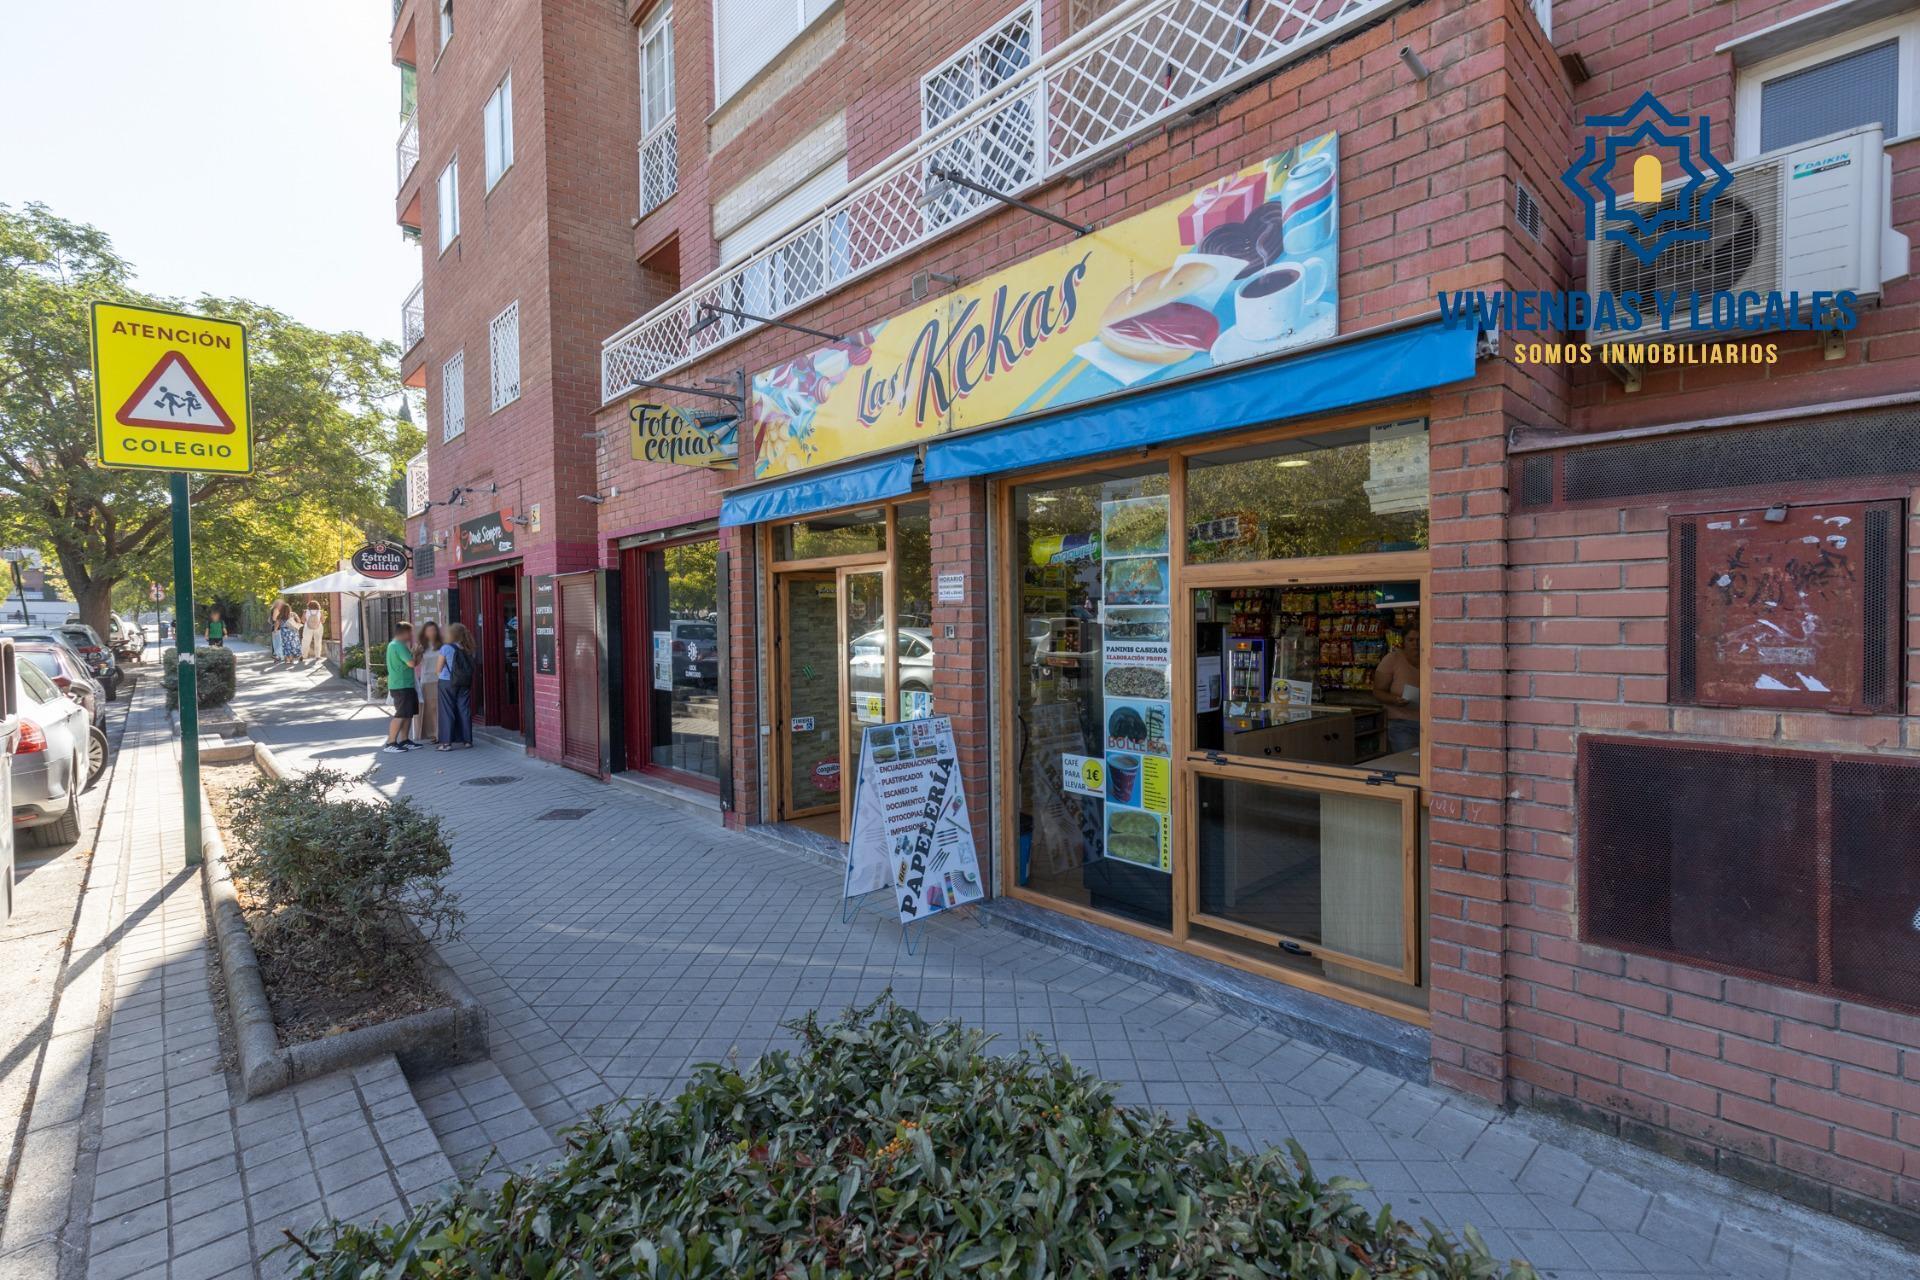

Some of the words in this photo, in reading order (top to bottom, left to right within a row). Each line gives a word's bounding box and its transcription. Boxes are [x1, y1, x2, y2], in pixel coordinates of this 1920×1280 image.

[112, 320, 231, 350] ATENCIÓN
[899, 251, 1093, 427] Kekas
[629, 404, 683, 437] Foto
[122, 438, 232, 458] COLEGIO
[645, 430, 715, 464] copias
[361, 552, 401, 562] Estrella
[363, 561, 399, 571] Galicia
[879, 757, 938, 773] ENCUADERNACIONES
[881, 771, 924, 786] PLASTIFICADOS
[1064, 769, 1080, 779] PARA
[1086, 769, 1100, 781] 1€
[884, 787, 910, 798] ESCANEO
[910, 785, 918, 793] DE
[886, 796, 927, 811] DOCUMENTOS
[888, 809, 924, 824] FOTOCOPIAS
[890, 821, 928, 836] IMPRESIONES
[901, 757, 955, 917] PAPELERÍA
